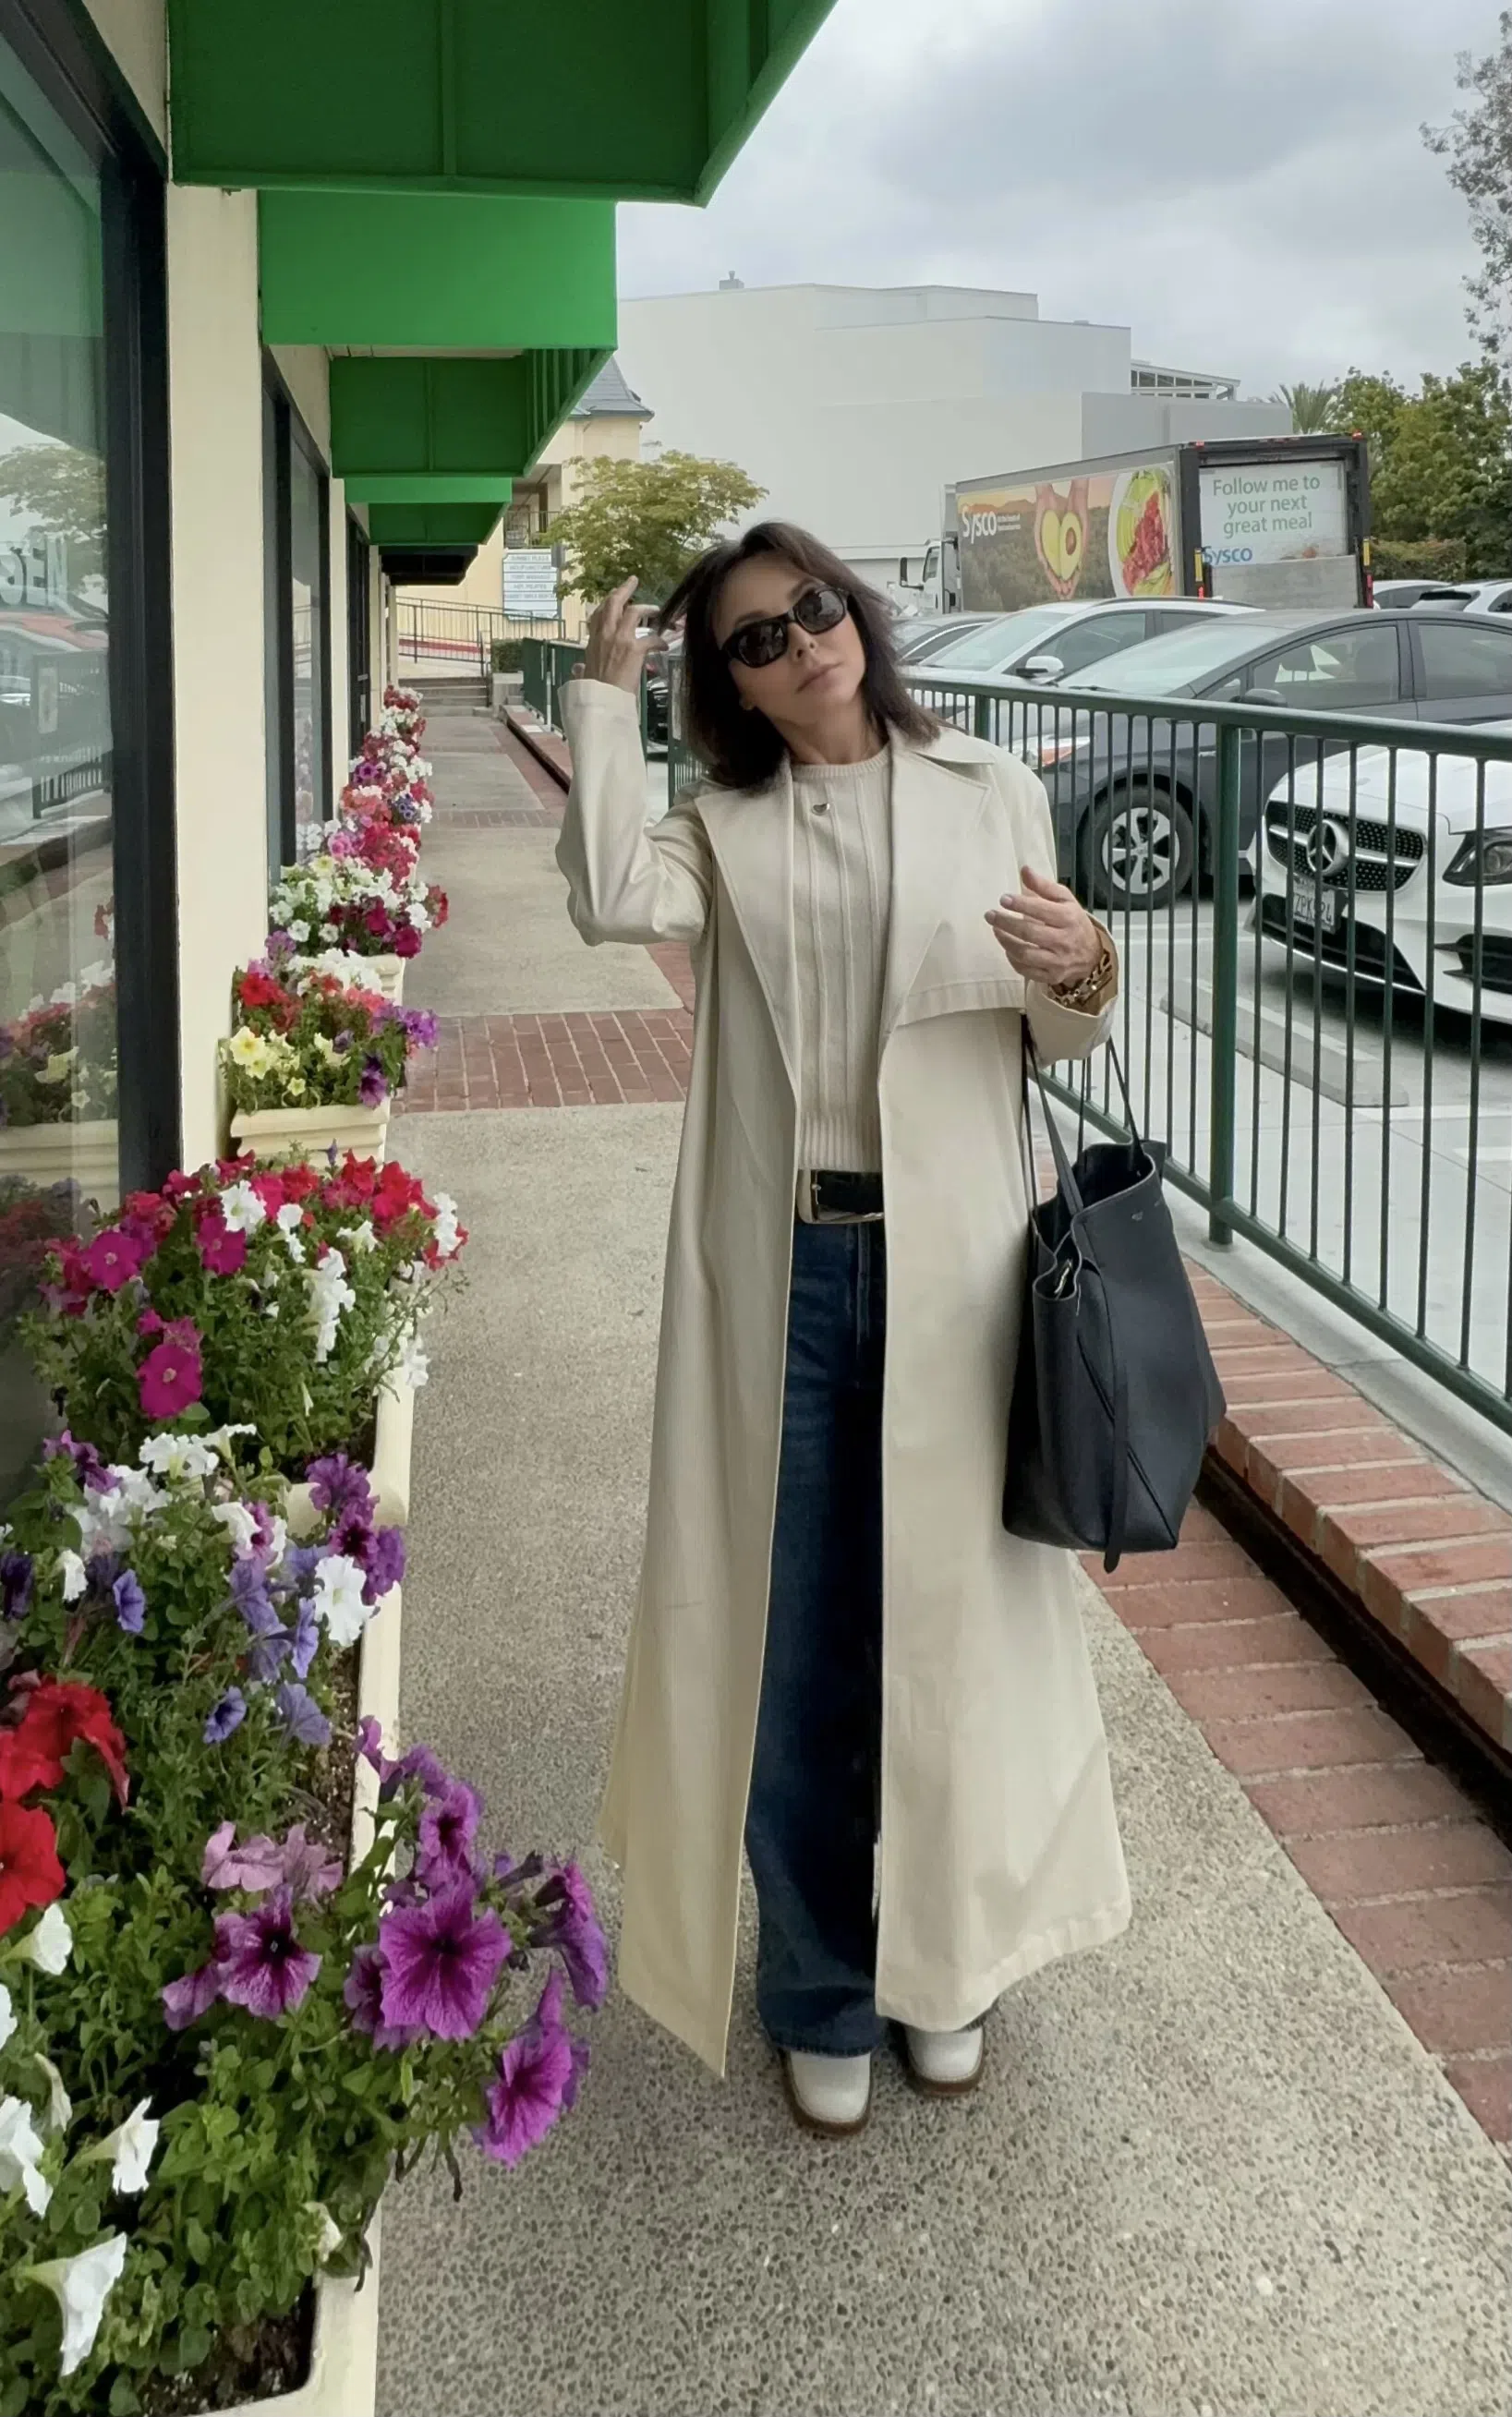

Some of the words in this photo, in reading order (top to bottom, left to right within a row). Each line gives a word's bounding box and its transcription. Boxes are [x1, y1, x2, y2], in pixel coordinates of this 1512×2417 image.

[1213, 477, 1267, 496] Follow
[1273, 478, 1299, 492] me
[1303, 475, 1320, 490] to
[1228, 499, 1266, 519] your
[1271, 495, 1307, 512] next
[962, 504, 997, 545] Sysco
[1224, 517, 1267, 539] great
[1273, 512, 1312, 531] meal
[1203, 546, 1253, 565] Sysco
